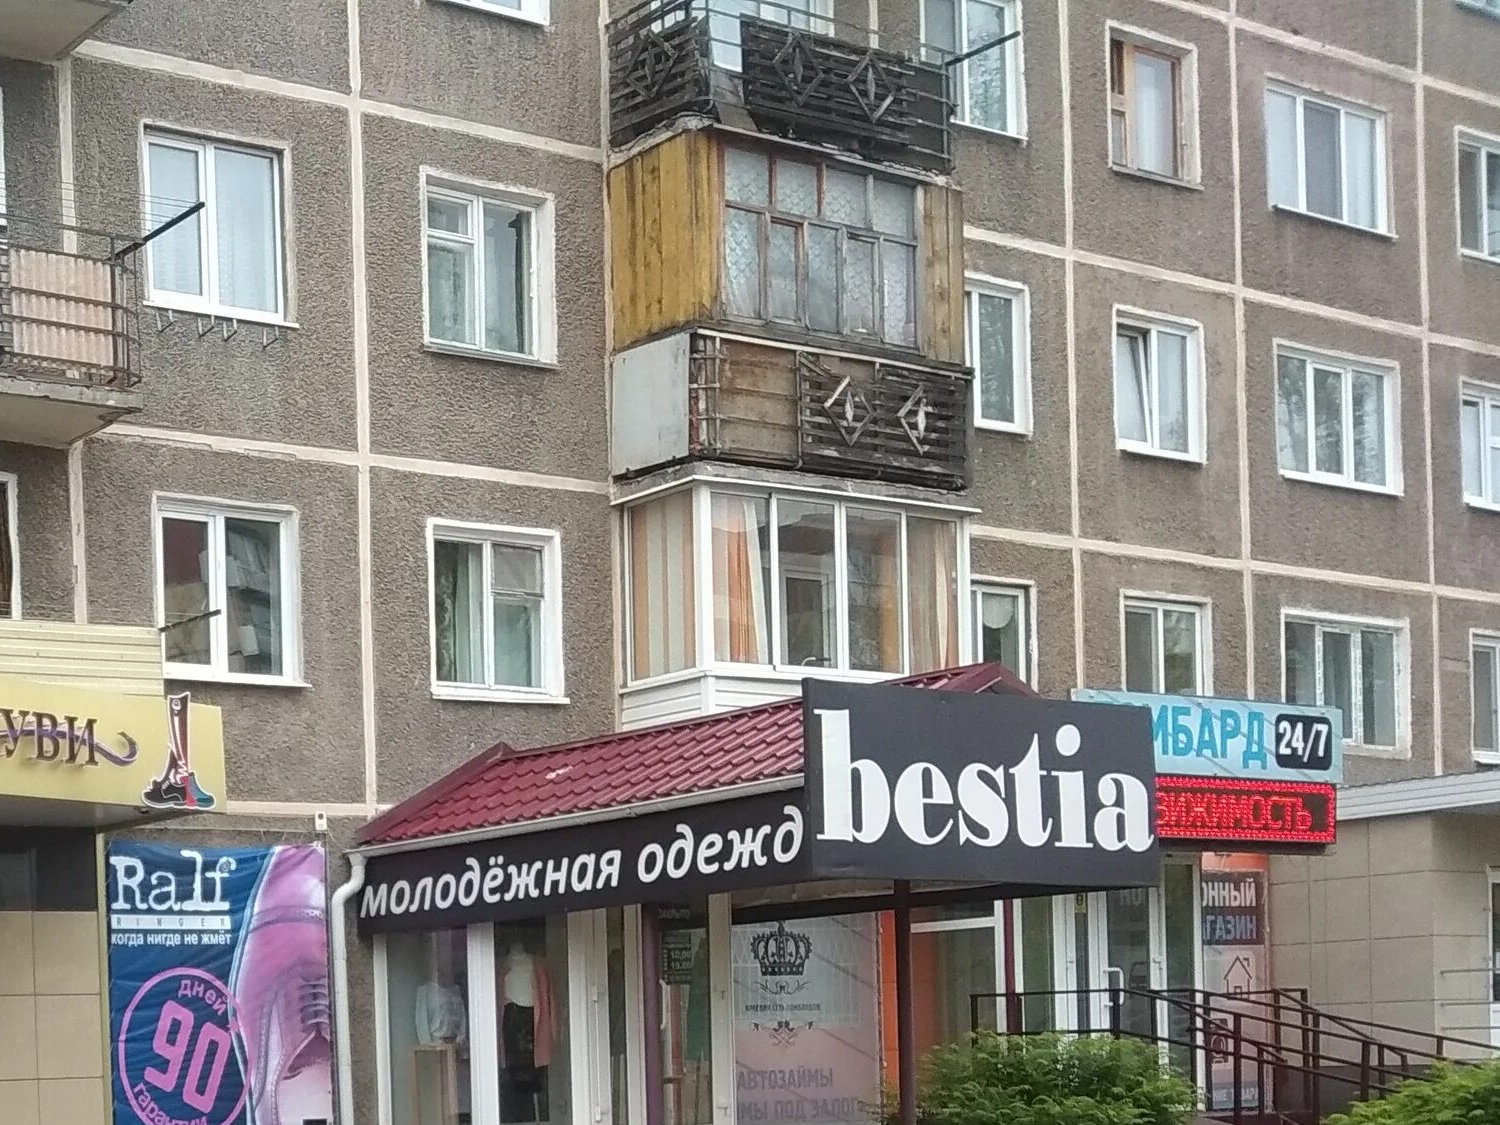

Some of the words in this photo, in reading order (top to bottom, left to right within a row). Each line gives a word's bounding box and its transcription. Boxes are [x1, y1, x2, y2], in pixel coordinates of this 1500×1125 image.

[813, 708, 1154, 852] bestia
[1278, 719, 1331, 762] 24/7
[359, 850, 621, 918] молодёжная
[637, 805, 803, 883] одежд
[111, 933, 144, 947] когда
[147, 933, 181, 947] нигде
[184, 933, 198, 945] не
[201, 930, 231, 945] жмёт
[144, 1000, 231, 1113] 90
